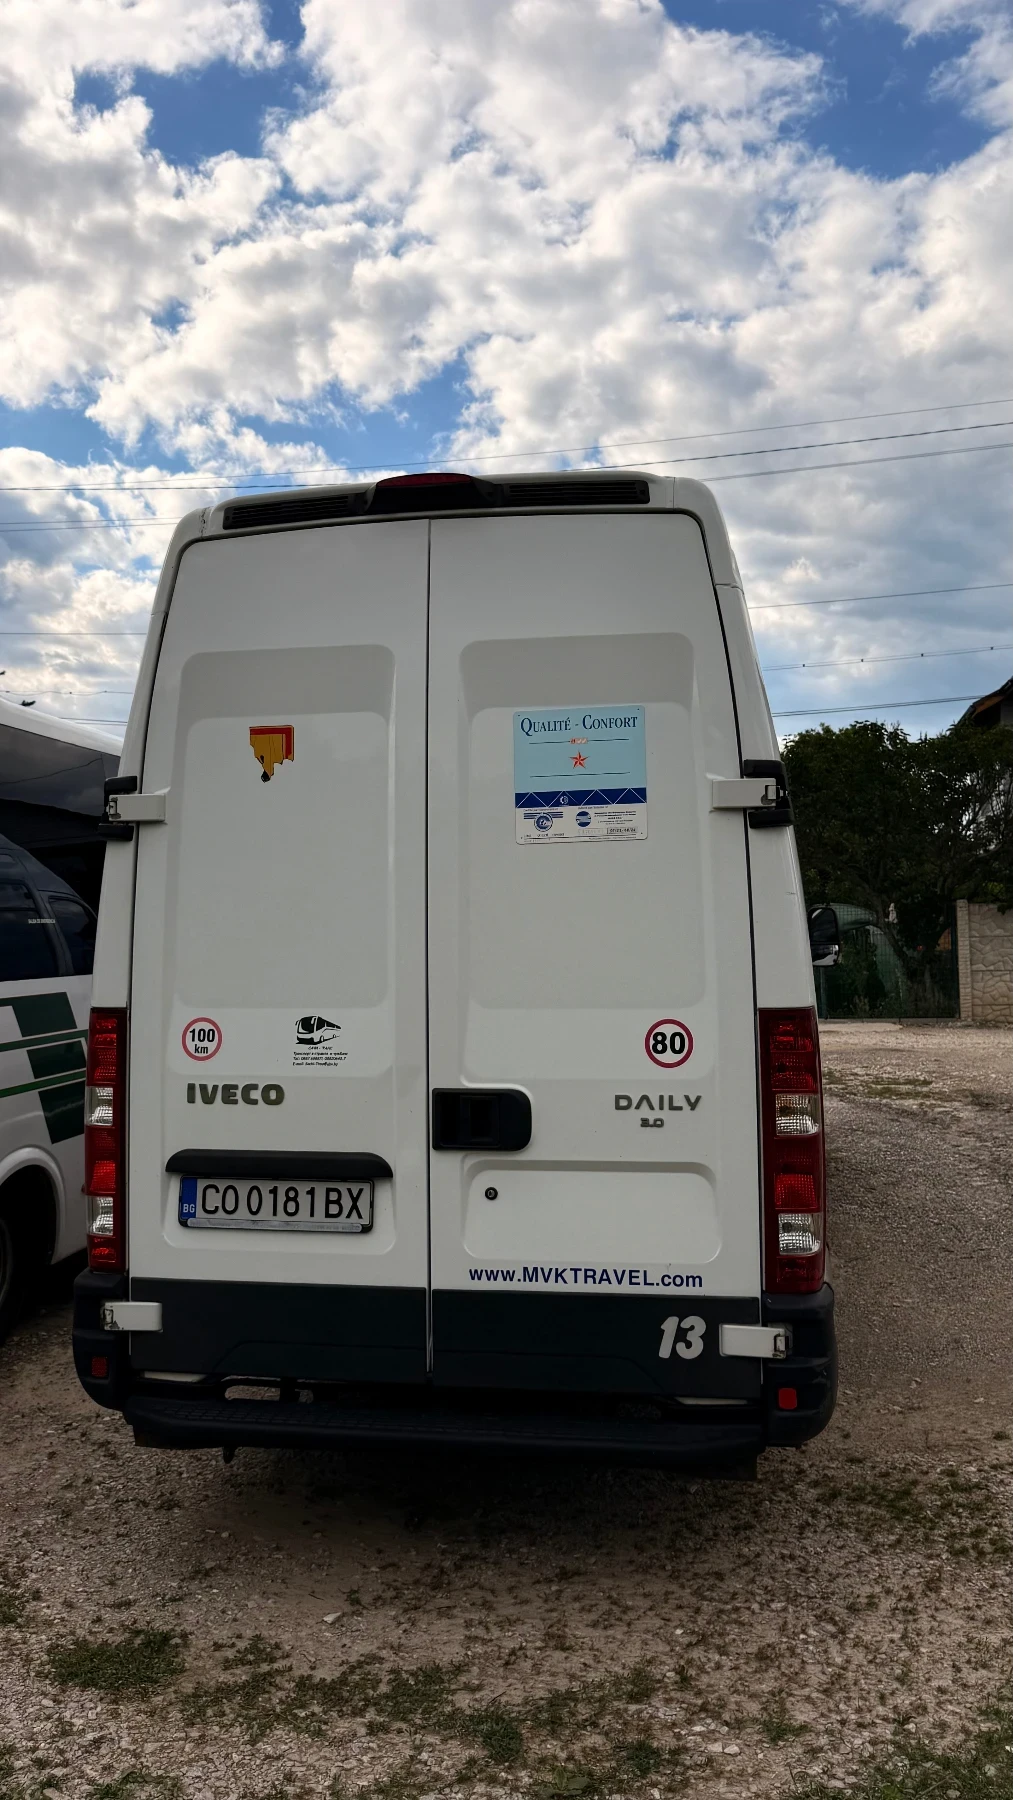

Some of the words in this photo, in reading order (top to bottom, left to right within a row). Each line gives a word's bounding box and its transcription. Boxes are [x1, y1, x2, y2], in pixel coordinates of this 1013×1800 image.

[520, 717, 571, 736] QUALITÉ
[582, 714, 638, 730] CONFORT
[189, 1028, 216, 1043] 100
[651, 1031, 686, 1055] 80
[194, 1044, 209, 1054] km
[187, 1083, 285, 1106] IVECO
[614, 1094, 702, 1111] DAILY
[183, 1203, 195, 1213] BG
[469, 1266, 704, 1288] www.MVKTRAVEL.com
[658, 1315, 707, 1360] 13
